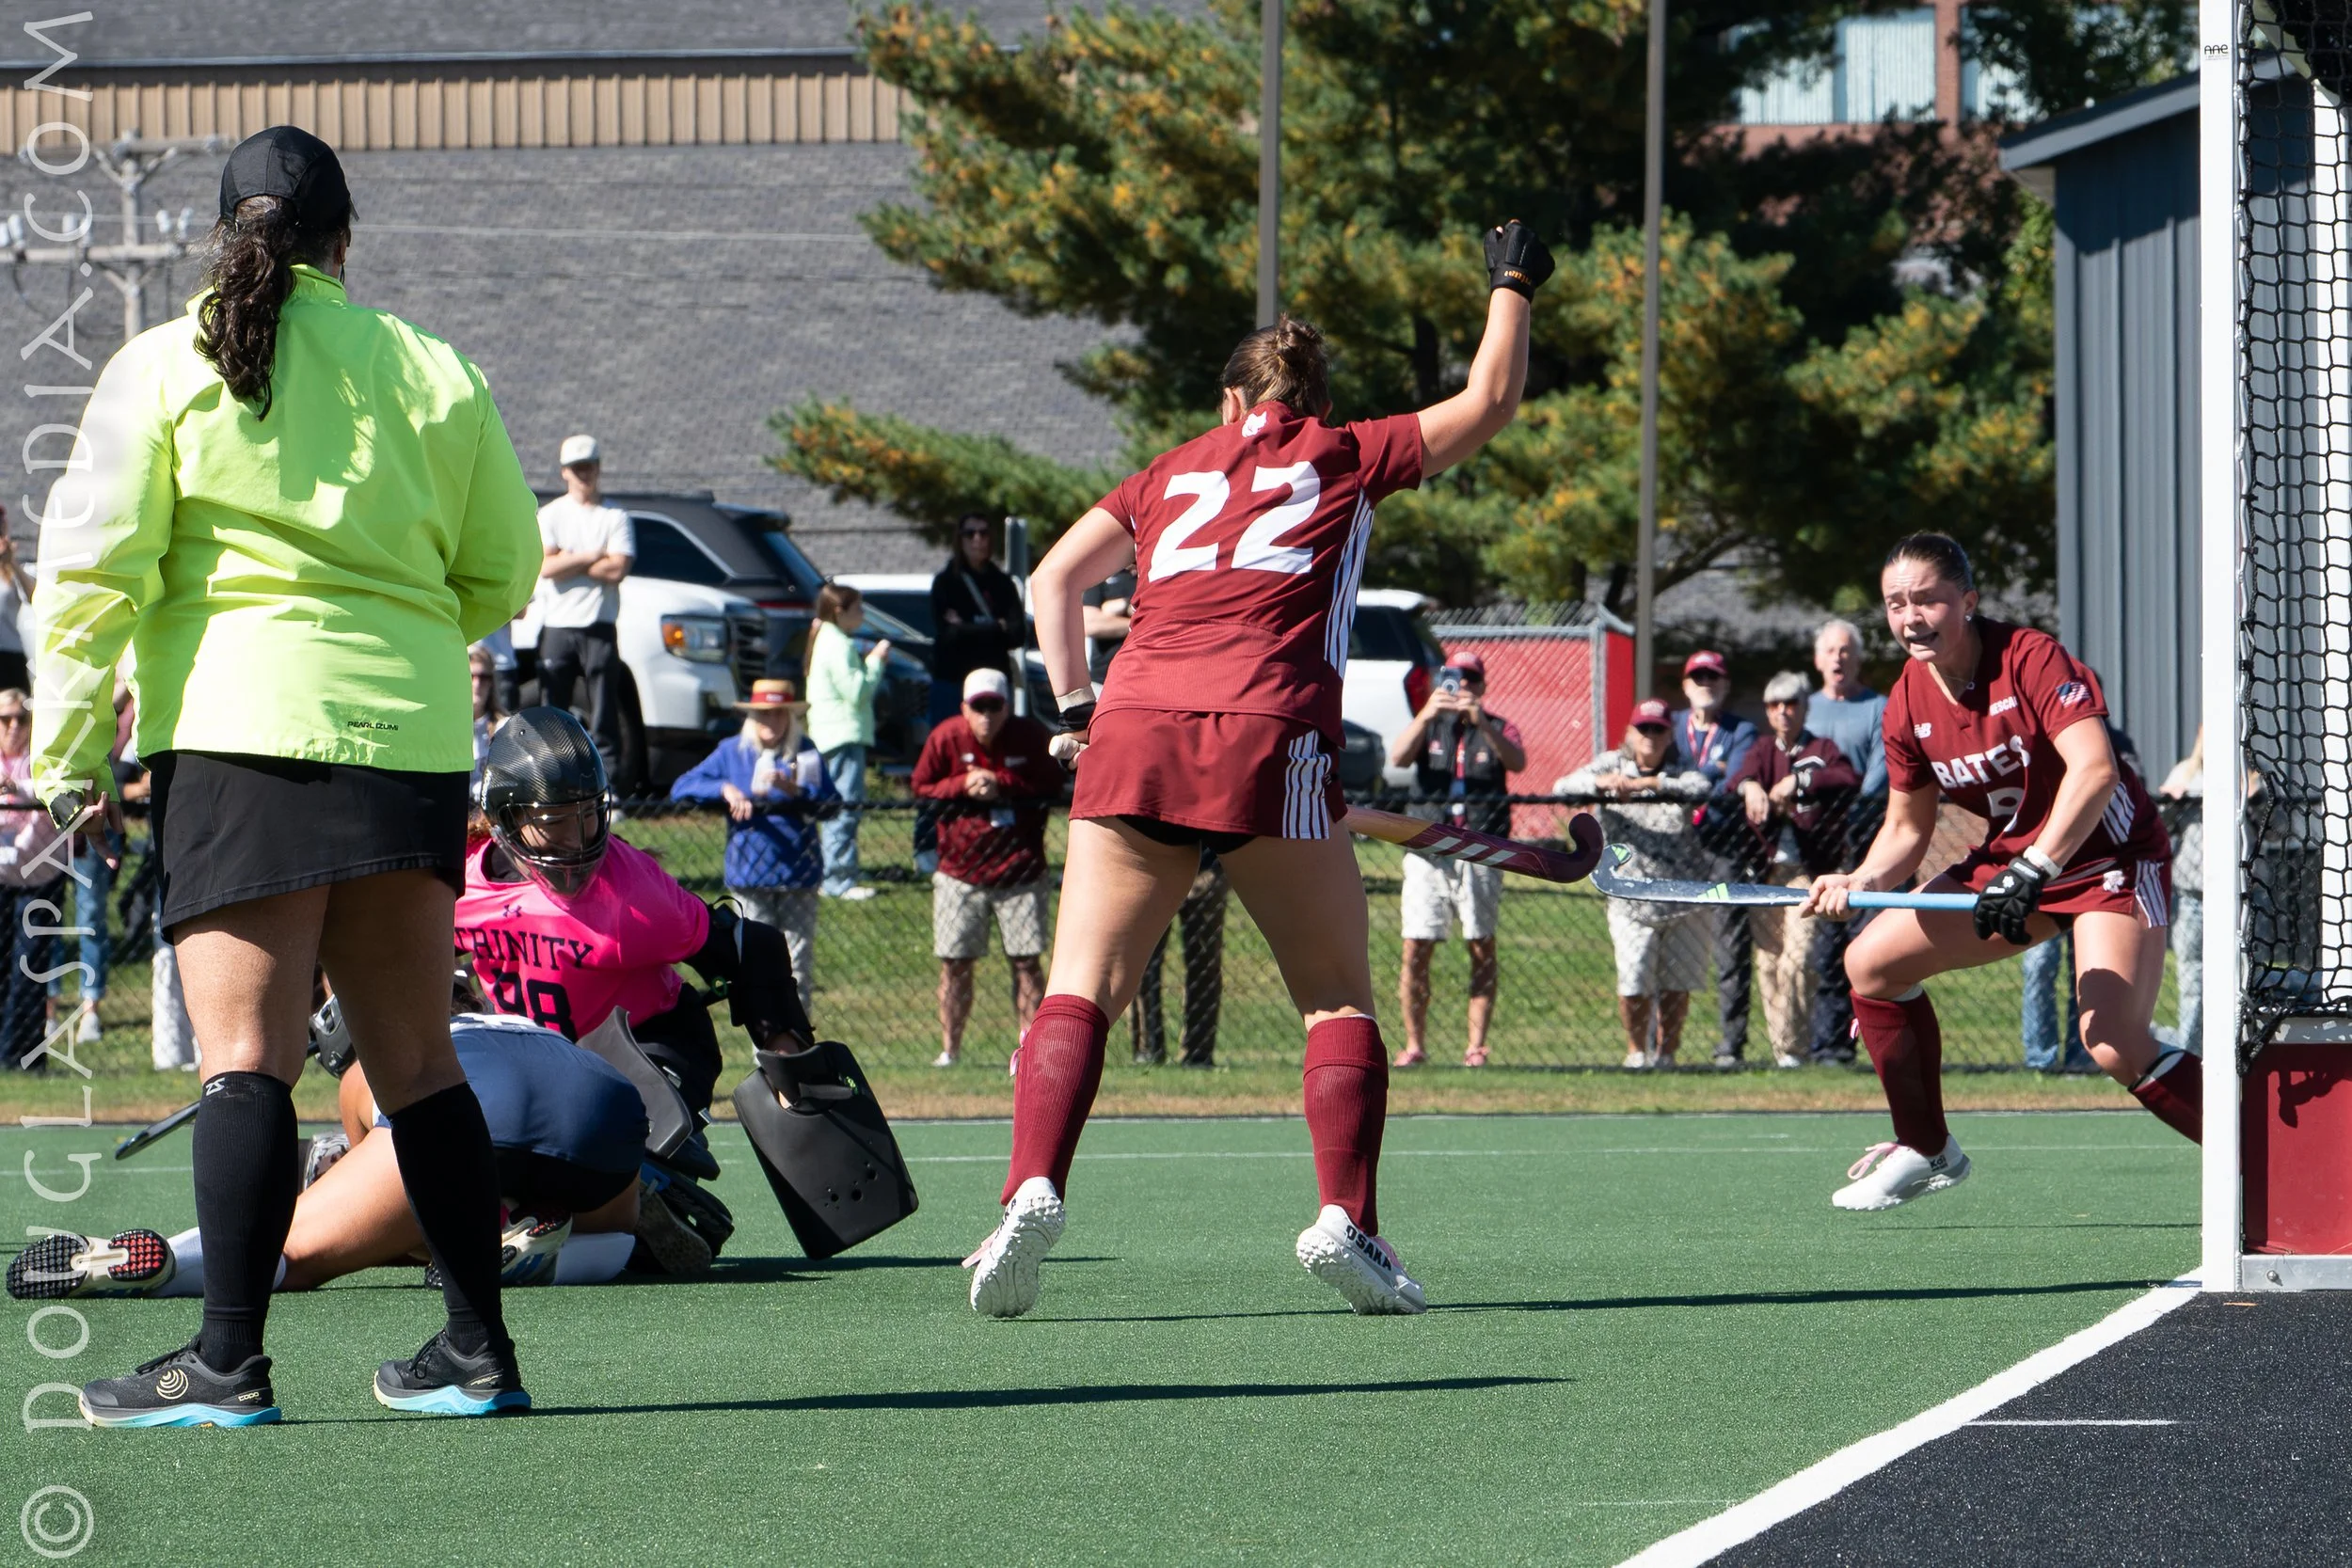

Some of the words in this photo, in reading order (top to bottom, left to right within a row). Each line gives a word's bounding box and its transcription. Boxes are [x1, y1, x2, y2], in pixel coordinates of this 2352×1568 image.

[1147, 461, 1321, 583] 22
[347, 721, 374, 729] PEARL
[1931, 734, 2031, 788] BATES
[1346, 1225, 1392, 1271] OSAKA
